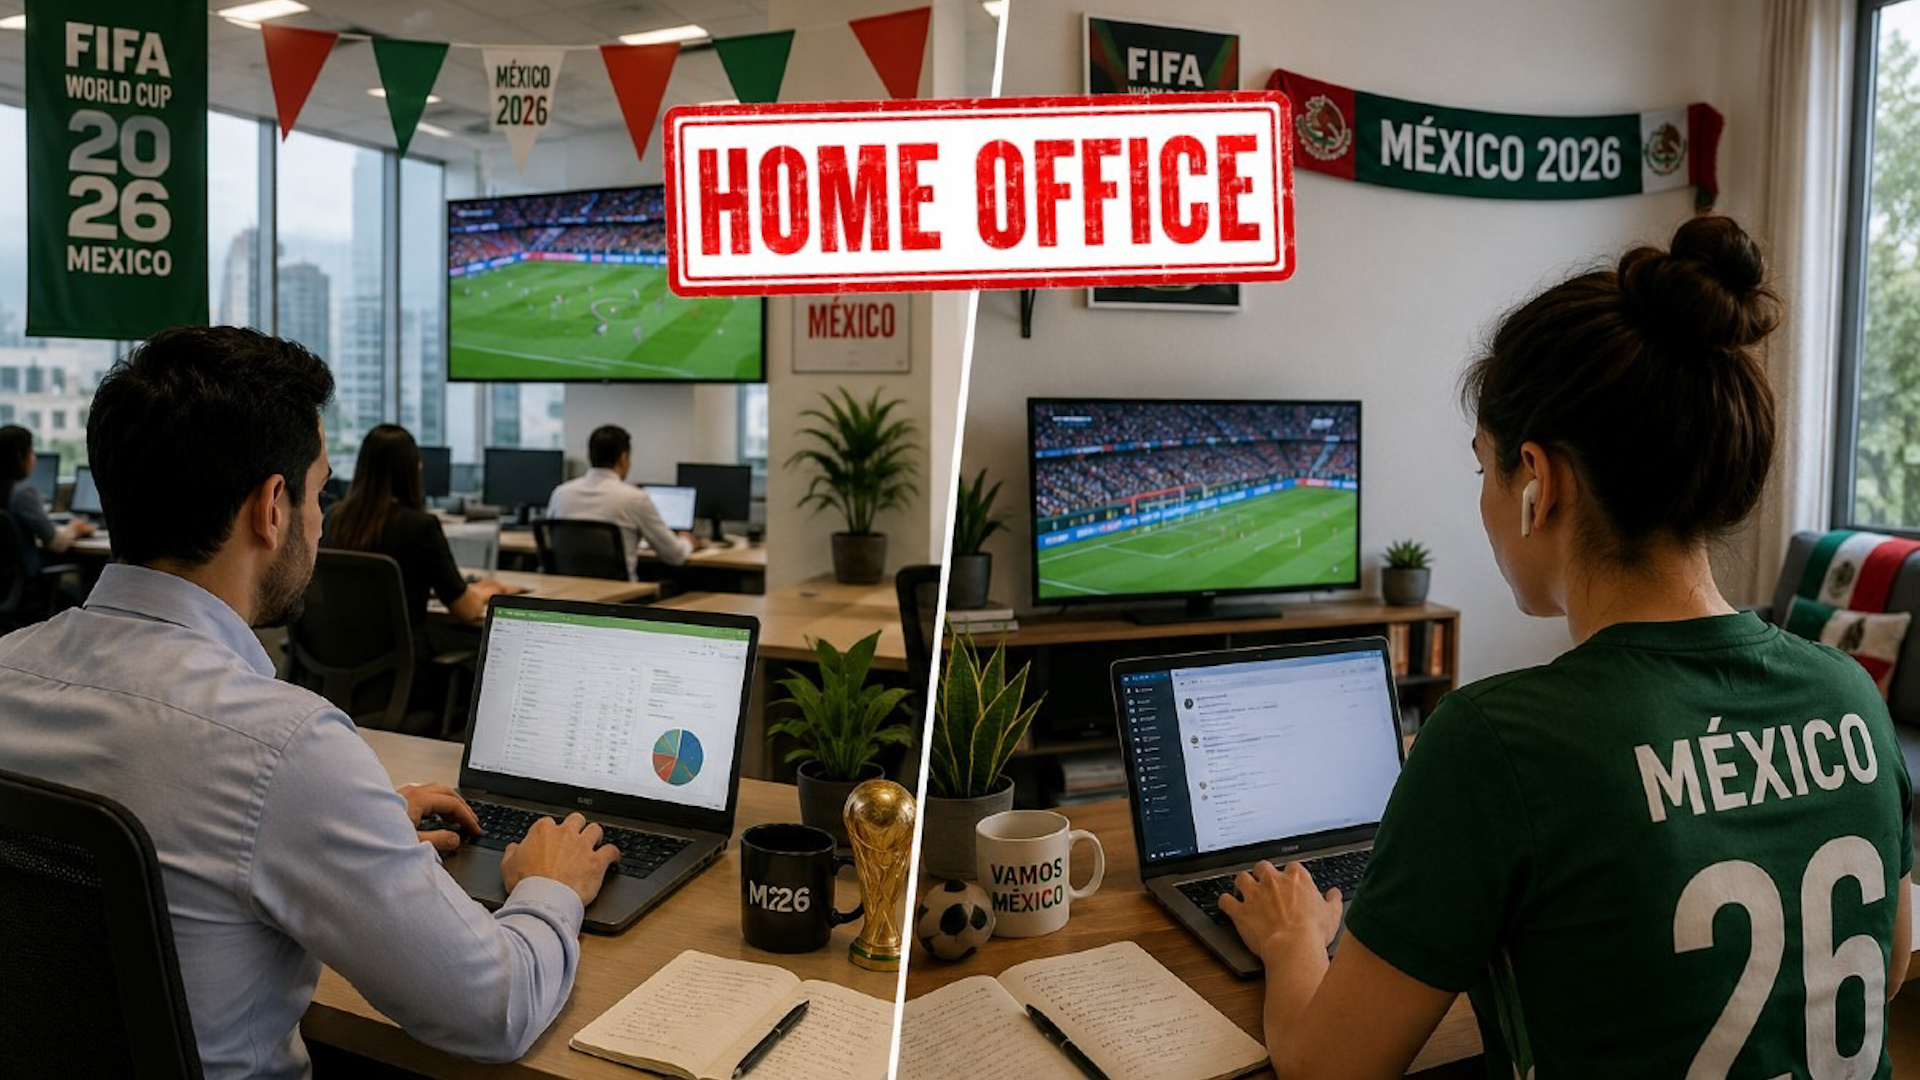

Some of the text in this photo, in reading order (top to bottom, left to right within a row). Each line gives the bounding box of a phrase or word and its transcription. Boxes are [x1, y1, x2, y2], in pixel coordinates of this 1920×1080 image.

[65, 21, 171, 78] FIFA
[1127, 47, 1204, 87] FIFA
[66, 74, 172, 108] WORLD CUP
[496, 60, 551, 90] MÉXICO
[497, 95, 548, 125] 2026
[68, 110, 171, 178] 20
[1380, 116, 1621, 182] MÉXICO 2026
[67, 175, 172, 242] 26
[66, 245, 172, 277] MEXICO
[808, 296, 895, 338] MÉXICO
[1634, 713, 1879, 823] MÉXICO
[991, 857, 1063, 886] VAMOS
[992, 885, 1063, 913] MÉXICO
[1673, 835, 1886, 1080] 26
